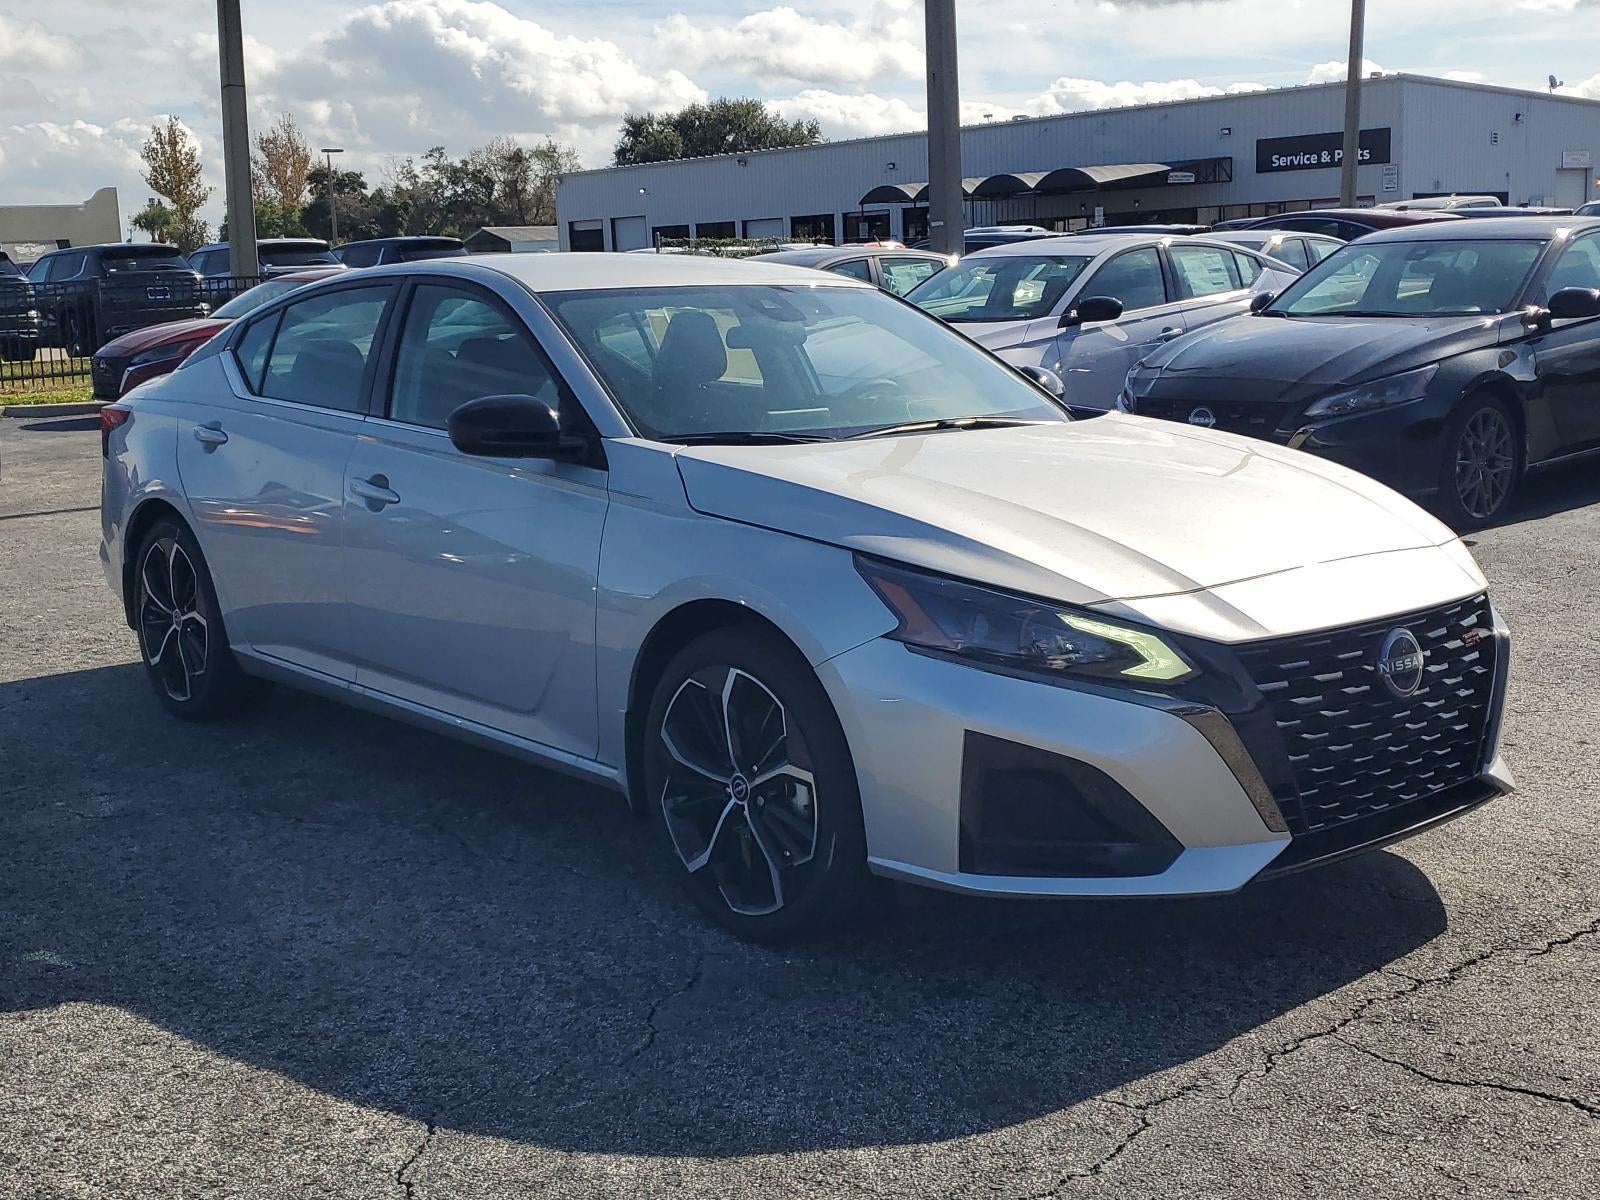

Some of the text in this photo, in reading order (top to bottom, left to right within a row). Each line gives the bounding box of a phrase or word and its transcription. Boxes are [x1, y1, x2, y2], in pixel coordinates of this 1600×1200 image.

[1272, 148, 1370, 167] Service & Pts
[1378, 652, 1424, 673] NISSAN
